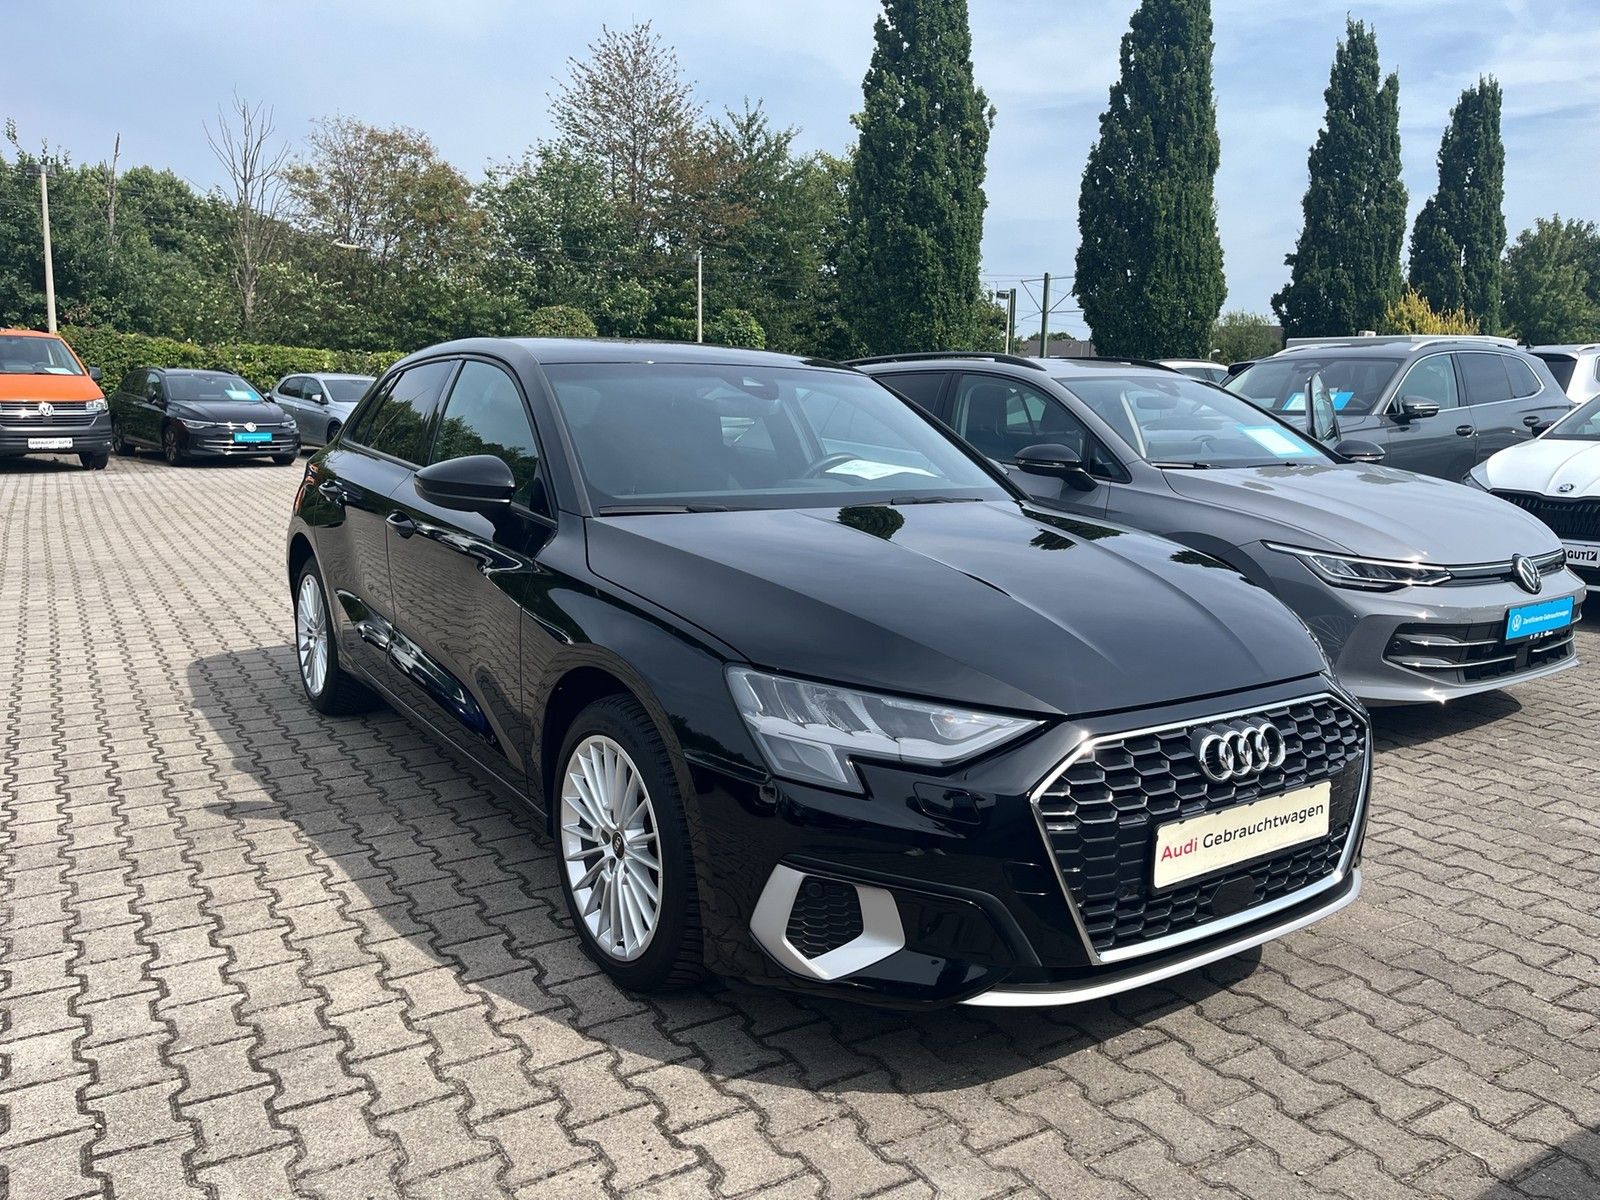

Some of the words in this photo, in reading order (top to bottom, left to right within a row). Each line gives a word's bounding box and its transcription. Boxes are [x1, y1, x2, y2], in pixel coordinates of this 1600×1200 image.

[1567, 550, 1587, 560] GUT
[1161, 837, 1198, 861] Audi
[1202, 804, 1324, 848] Gebrauchtwagen
